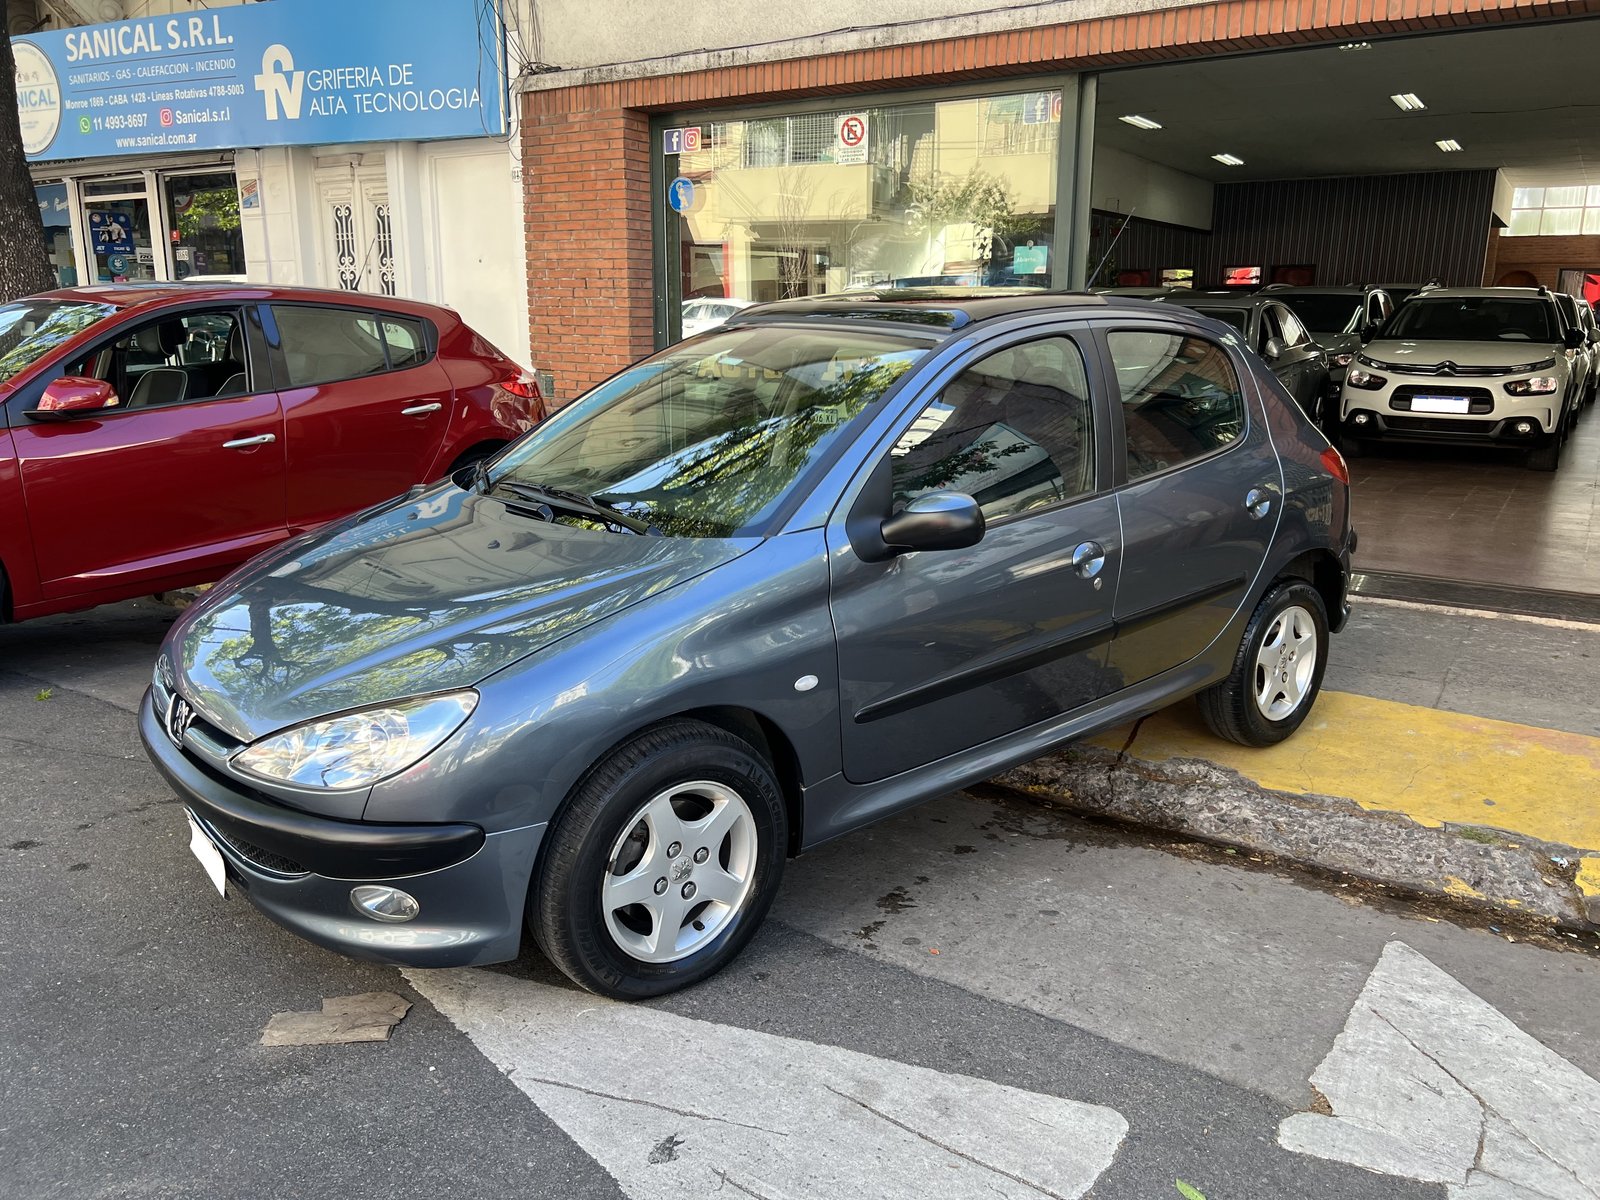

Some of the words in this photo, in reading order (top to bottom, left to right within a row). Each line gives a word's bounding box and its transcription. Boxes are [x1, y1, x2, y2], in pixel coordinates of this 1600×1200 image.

[65, 23, 162, 62] SANICAL
[166, 15, 234, 50] S.R.L.
[68, 71, 110, 85] SANITARIOS
[115, 68, 132, 80] GAS
[137, 63, 189, 78] CALEFACCION
[195, 58, 236, 72] INCENDIO
[307, 65, 384, 91] GRIFERIA
[388, 63, 414, 86] DE
[65, 99, 88, 109] Monroe
[108, 94, 128, 105] CABA
[175, 87, 208, 100] Rotativas
[208, 84, 245, 96] 4788-5003
[309, 96, 348, 117] ALTA
[353, 88, 483, 114] TECNOLOGIA
[93, 117, 103, 131] 11
[105, 113, 148, 129] 4993-8697
[176, 106, 231, 124] Sanical.s.r.l
[116, 132, 197, 148] www.sanical.com.ar
